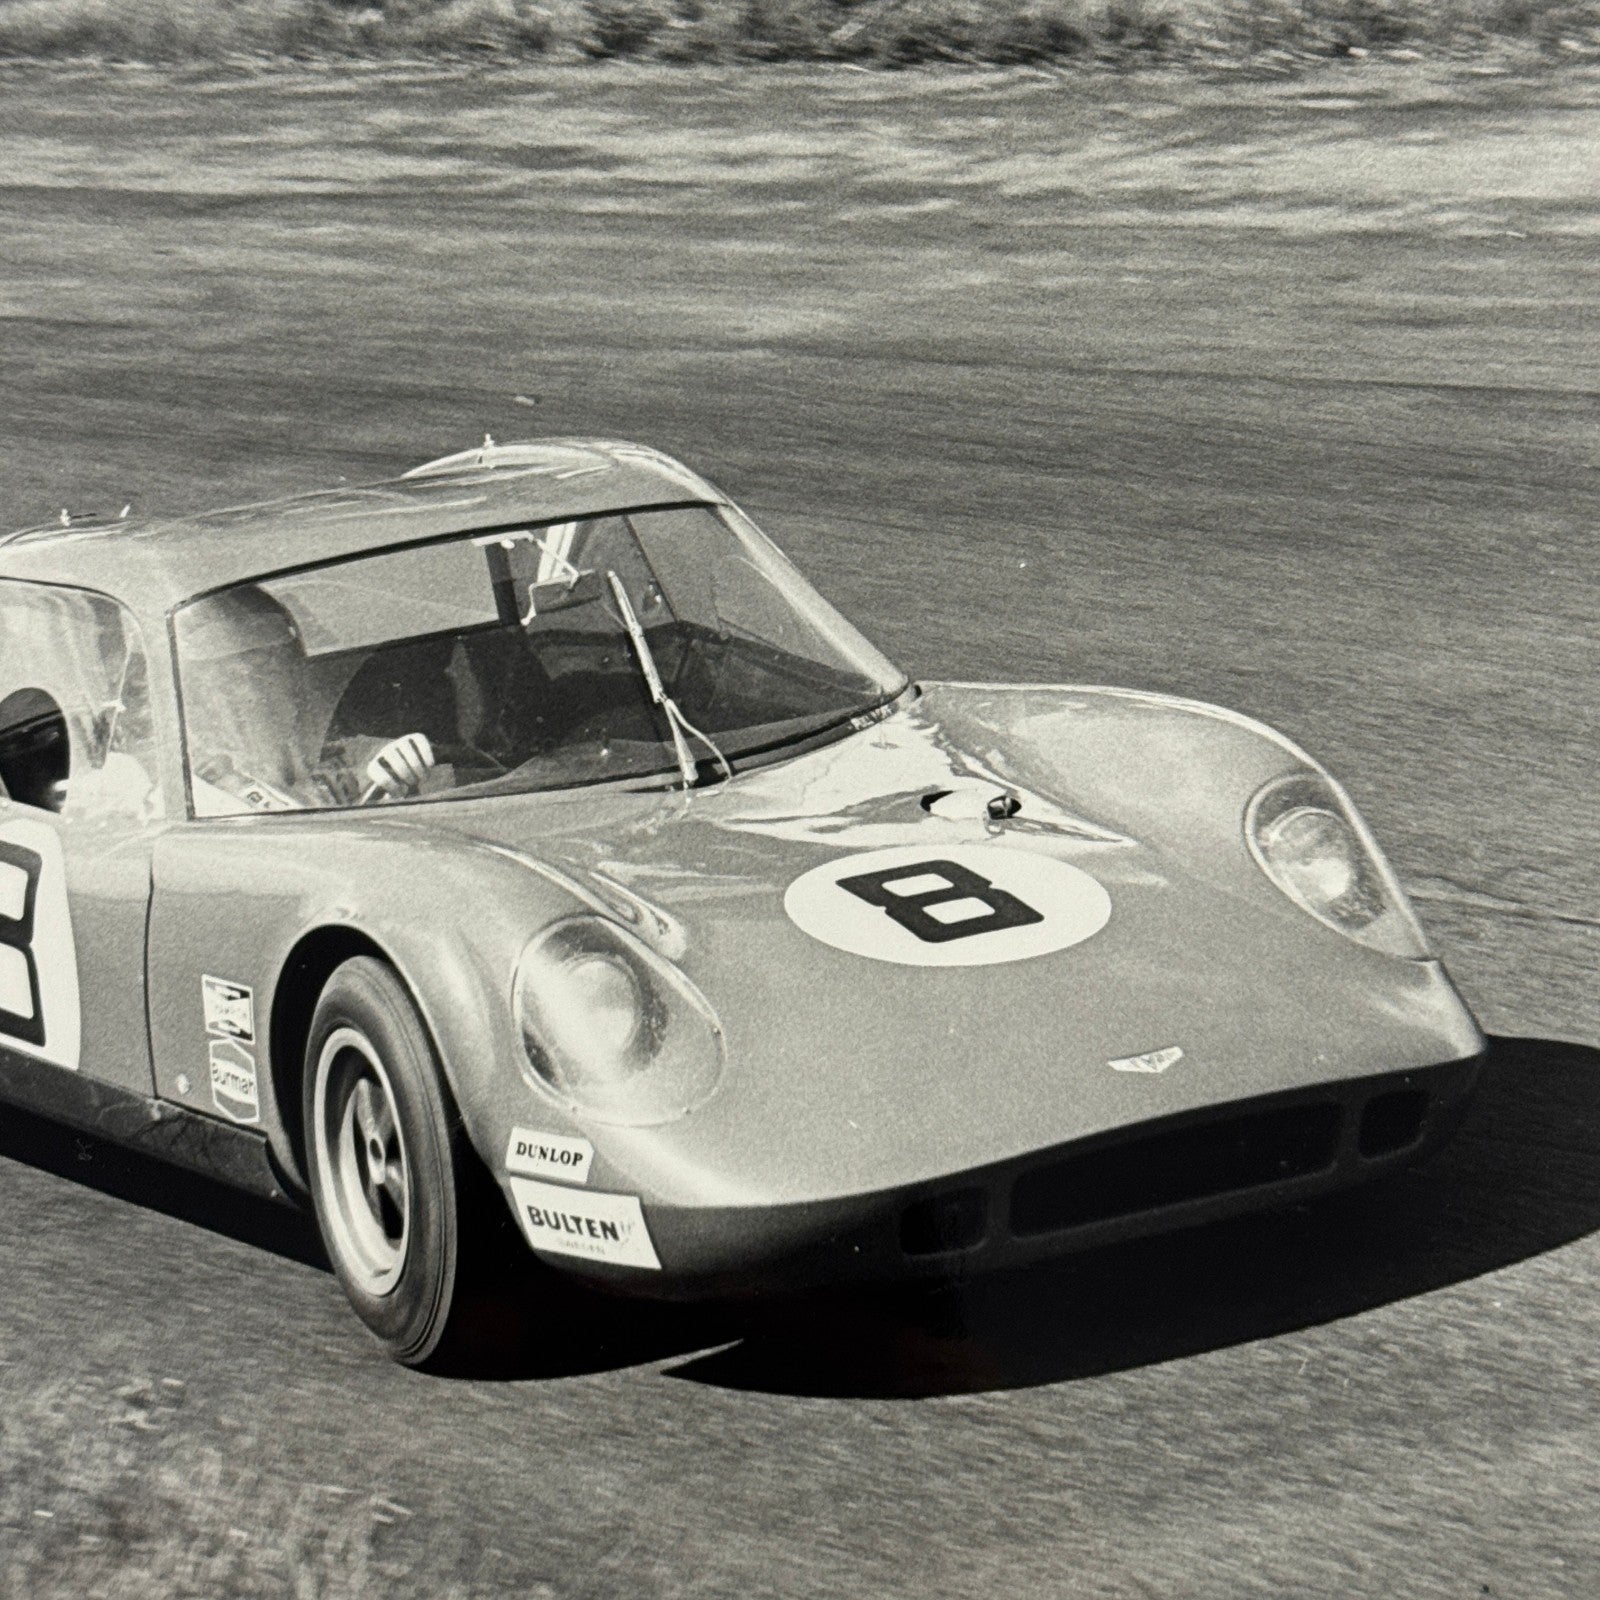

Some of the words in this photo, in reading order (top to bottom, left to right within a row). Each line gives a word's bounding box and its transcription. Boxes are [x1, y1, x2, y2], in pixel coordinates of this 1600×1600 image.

[834, 859, 1045, 944] 8
[515, 1141, 584, 1167] DUNLOP
[526, 1204, 620, 1242] BULTEN
